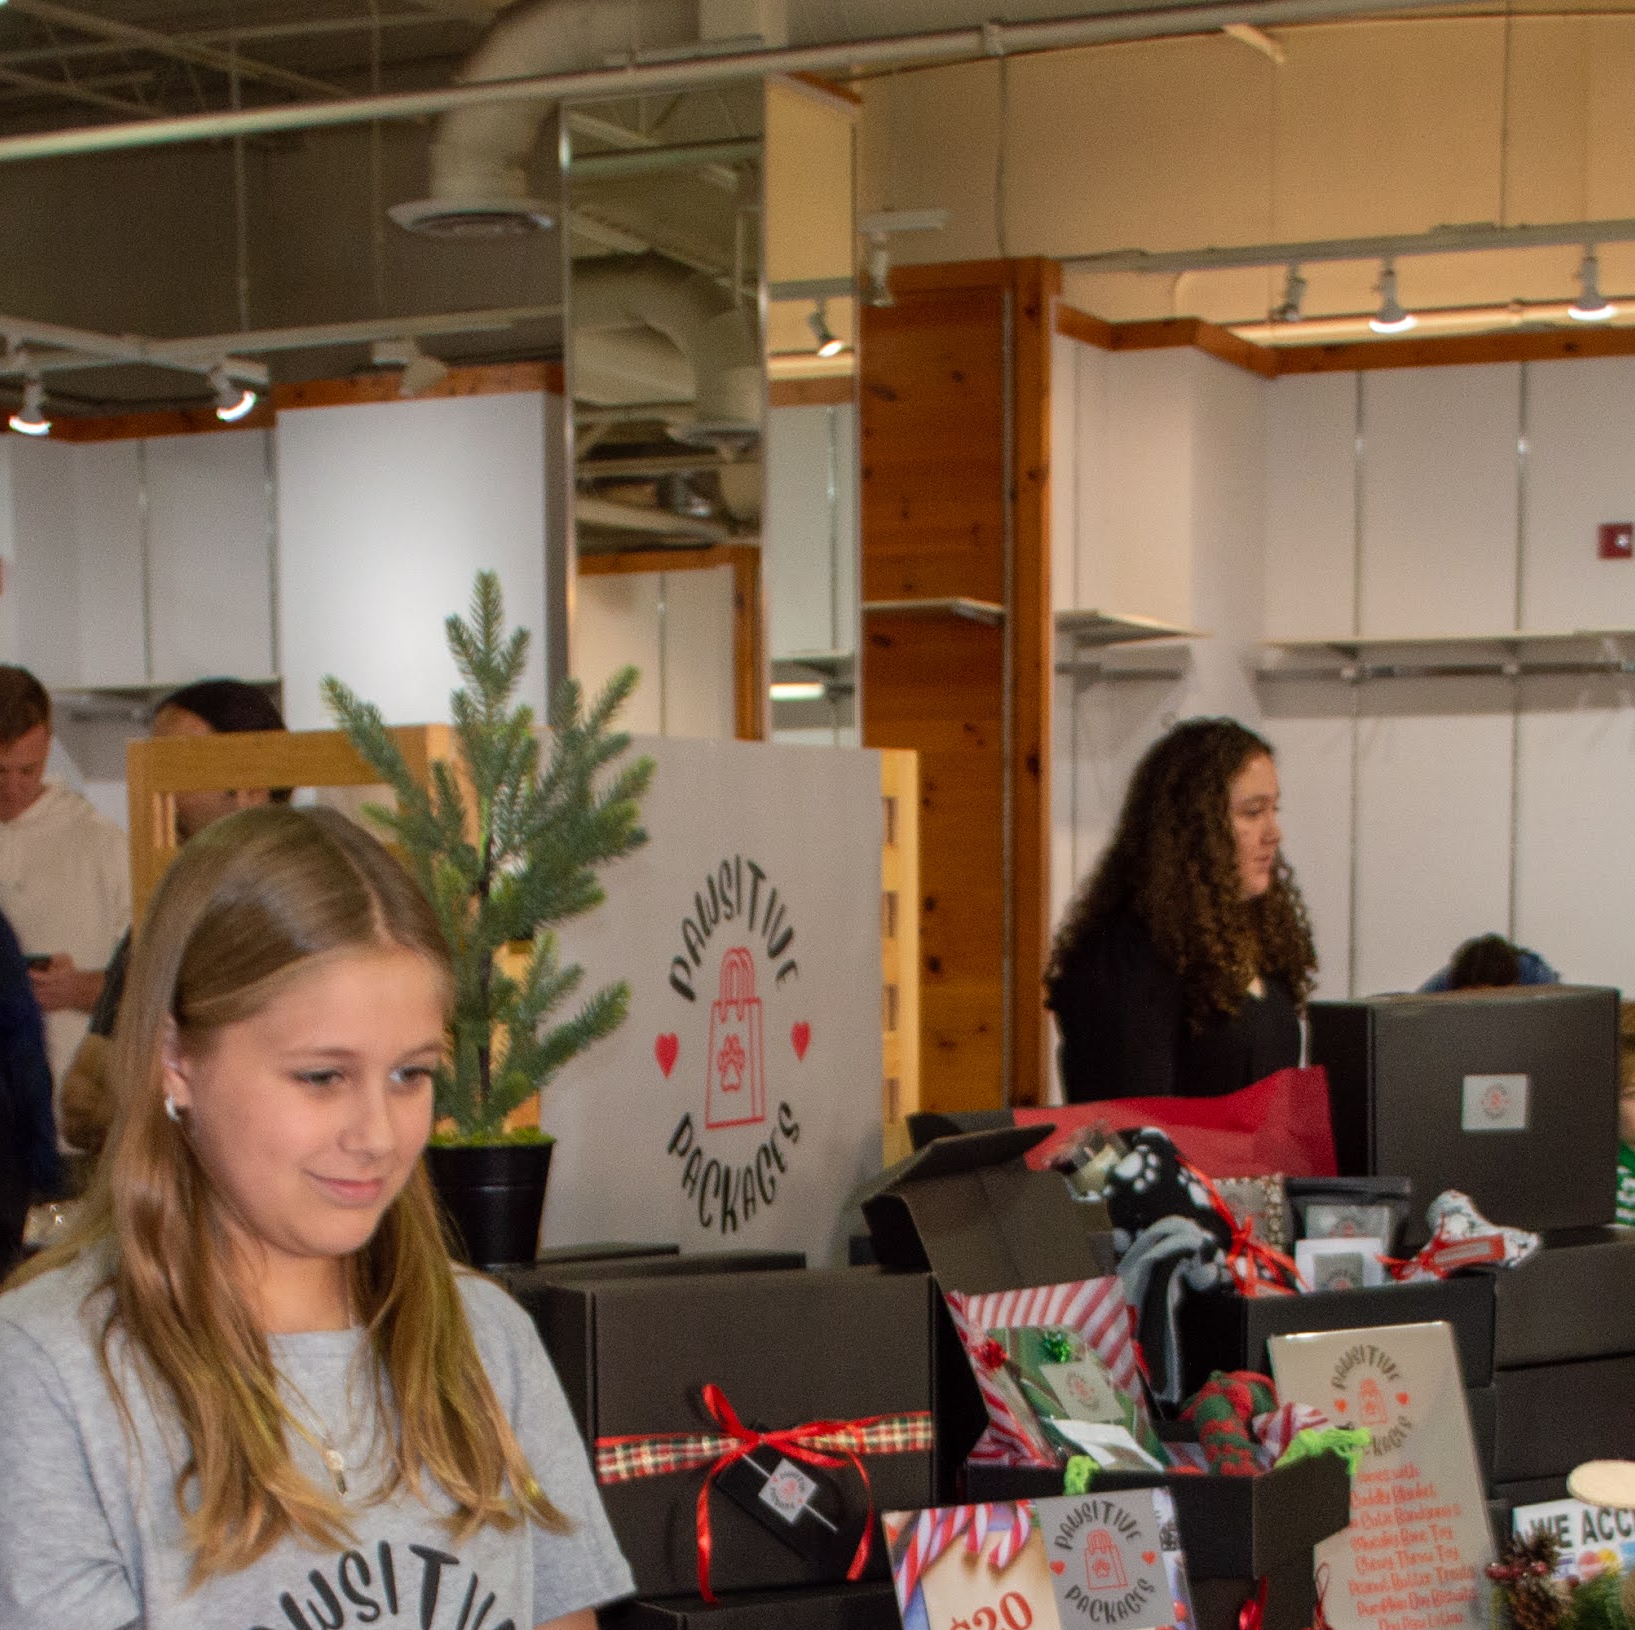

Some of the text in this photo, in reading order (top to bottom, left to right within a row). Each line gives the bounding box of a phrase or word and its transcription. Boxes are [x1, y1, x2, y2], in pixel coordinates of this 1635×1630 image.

[668, 854, 800, 1002] PAWSITIVE
[668, 1101, 801, 1234] PACKAGES
[1054, 1499, 1141, 1551] PAWSITIVE
[1530, 1513, 1572, 1549] WE
[1065, 1578, 1156, 1624] PACKAGES
